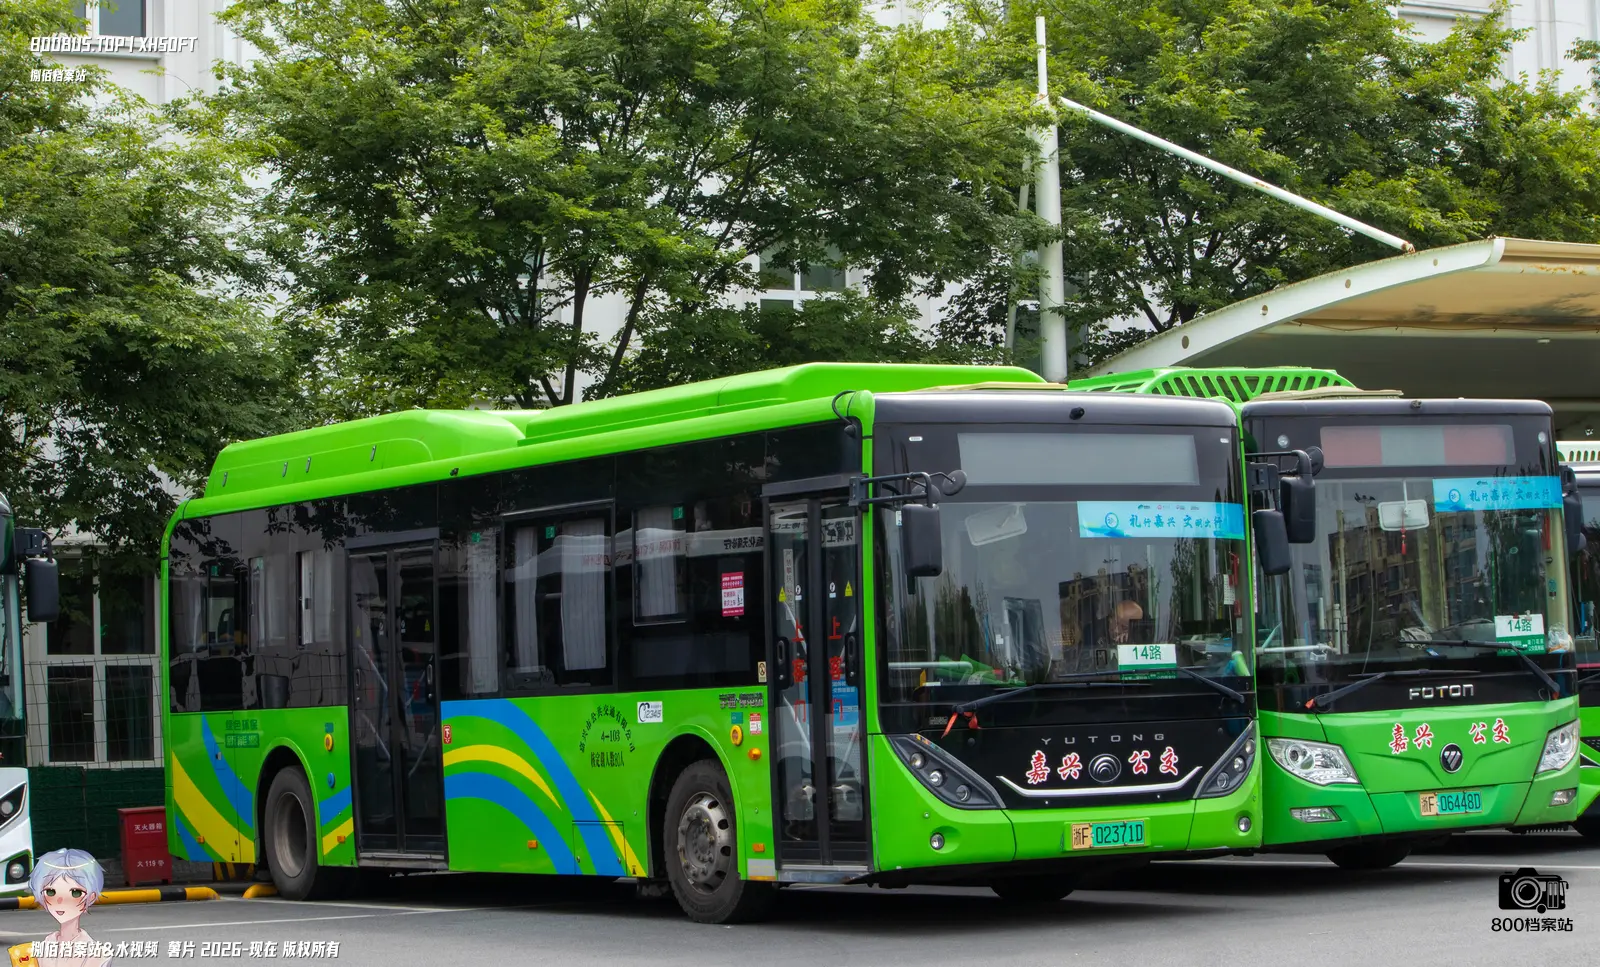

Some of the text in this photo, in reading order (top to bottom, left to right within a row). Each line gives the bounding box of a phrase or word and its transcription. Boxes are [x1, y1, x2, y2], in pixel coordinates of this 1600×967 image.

[1507, 618, 1532, 633] 14路
[1132, 645, 1162, 661] 14路
[1408, 684, 1474, 700] FOTON
[644, 709, 662, 719] 12345
[1041, 733, 1165, 746] YUTONG
[1389, 718, 1511, 755] 嘉兴 公交
[1026, 746, 1179, 784] 嘉兴 公交
